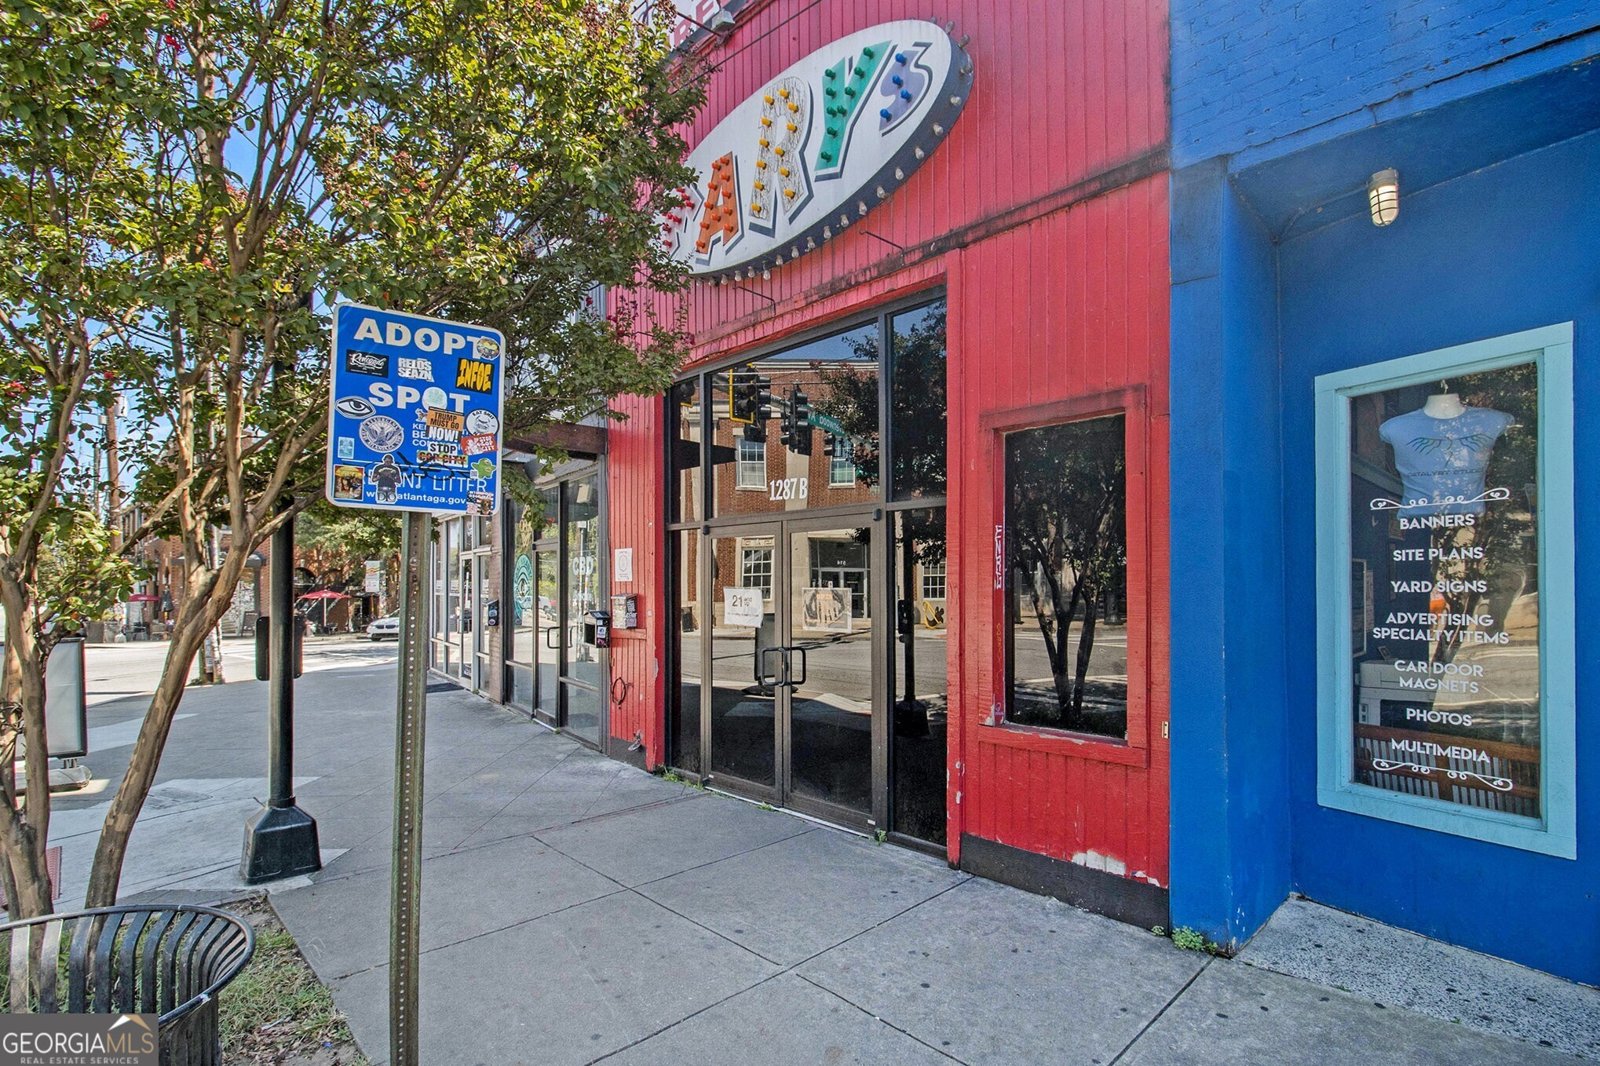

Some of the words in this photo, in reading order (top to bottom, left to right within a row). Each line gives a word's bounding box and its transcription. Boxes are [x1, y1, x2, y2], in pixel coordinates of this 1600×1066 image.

[353, 318, 480, 359] ADOPT
[368, 382, 470, 413] SPT
[429, 418, 449, 428] MUST
[450, 421, 460, 430] GO
[434, 412, 458, 422] TRUMP
[428, 426, 460, 443] NOW!
[429, 443, 457, 454] STOP
[433, 474, 488, 492] LITTER
[769, 478, 797, 501] 1287
[798, 477, 808, 500] B
[366, 490, 466, 504] watlantaga.gov
[1400, 513, 1475, 530] BANNERS
[1392, 548, 1425, 562] SITE
[1428, 546, 1484, 560] PLANS
[572, 556, 594, 576] CBD
[1391, 580, 1432, 593] YARD
[1437, 580, 1487, 593] SIGNS
[732, 594, 743, 607] 21
[1385, 612, 1494, 627] ADVERTISING
[1372, 628, 1455, 642] SPECIALTY
[1459, 630, 1510, 644] ITEMS
[1394, 659, 1428, 673] CAR
[1432, 663, 1484, 677] DOOR
[1399, 676, 1479, 694] MAGNETS
[1406, 708, 1473, 727] PHOTOS
[1391, 738, 1491, 763] MULTIMEDIA
